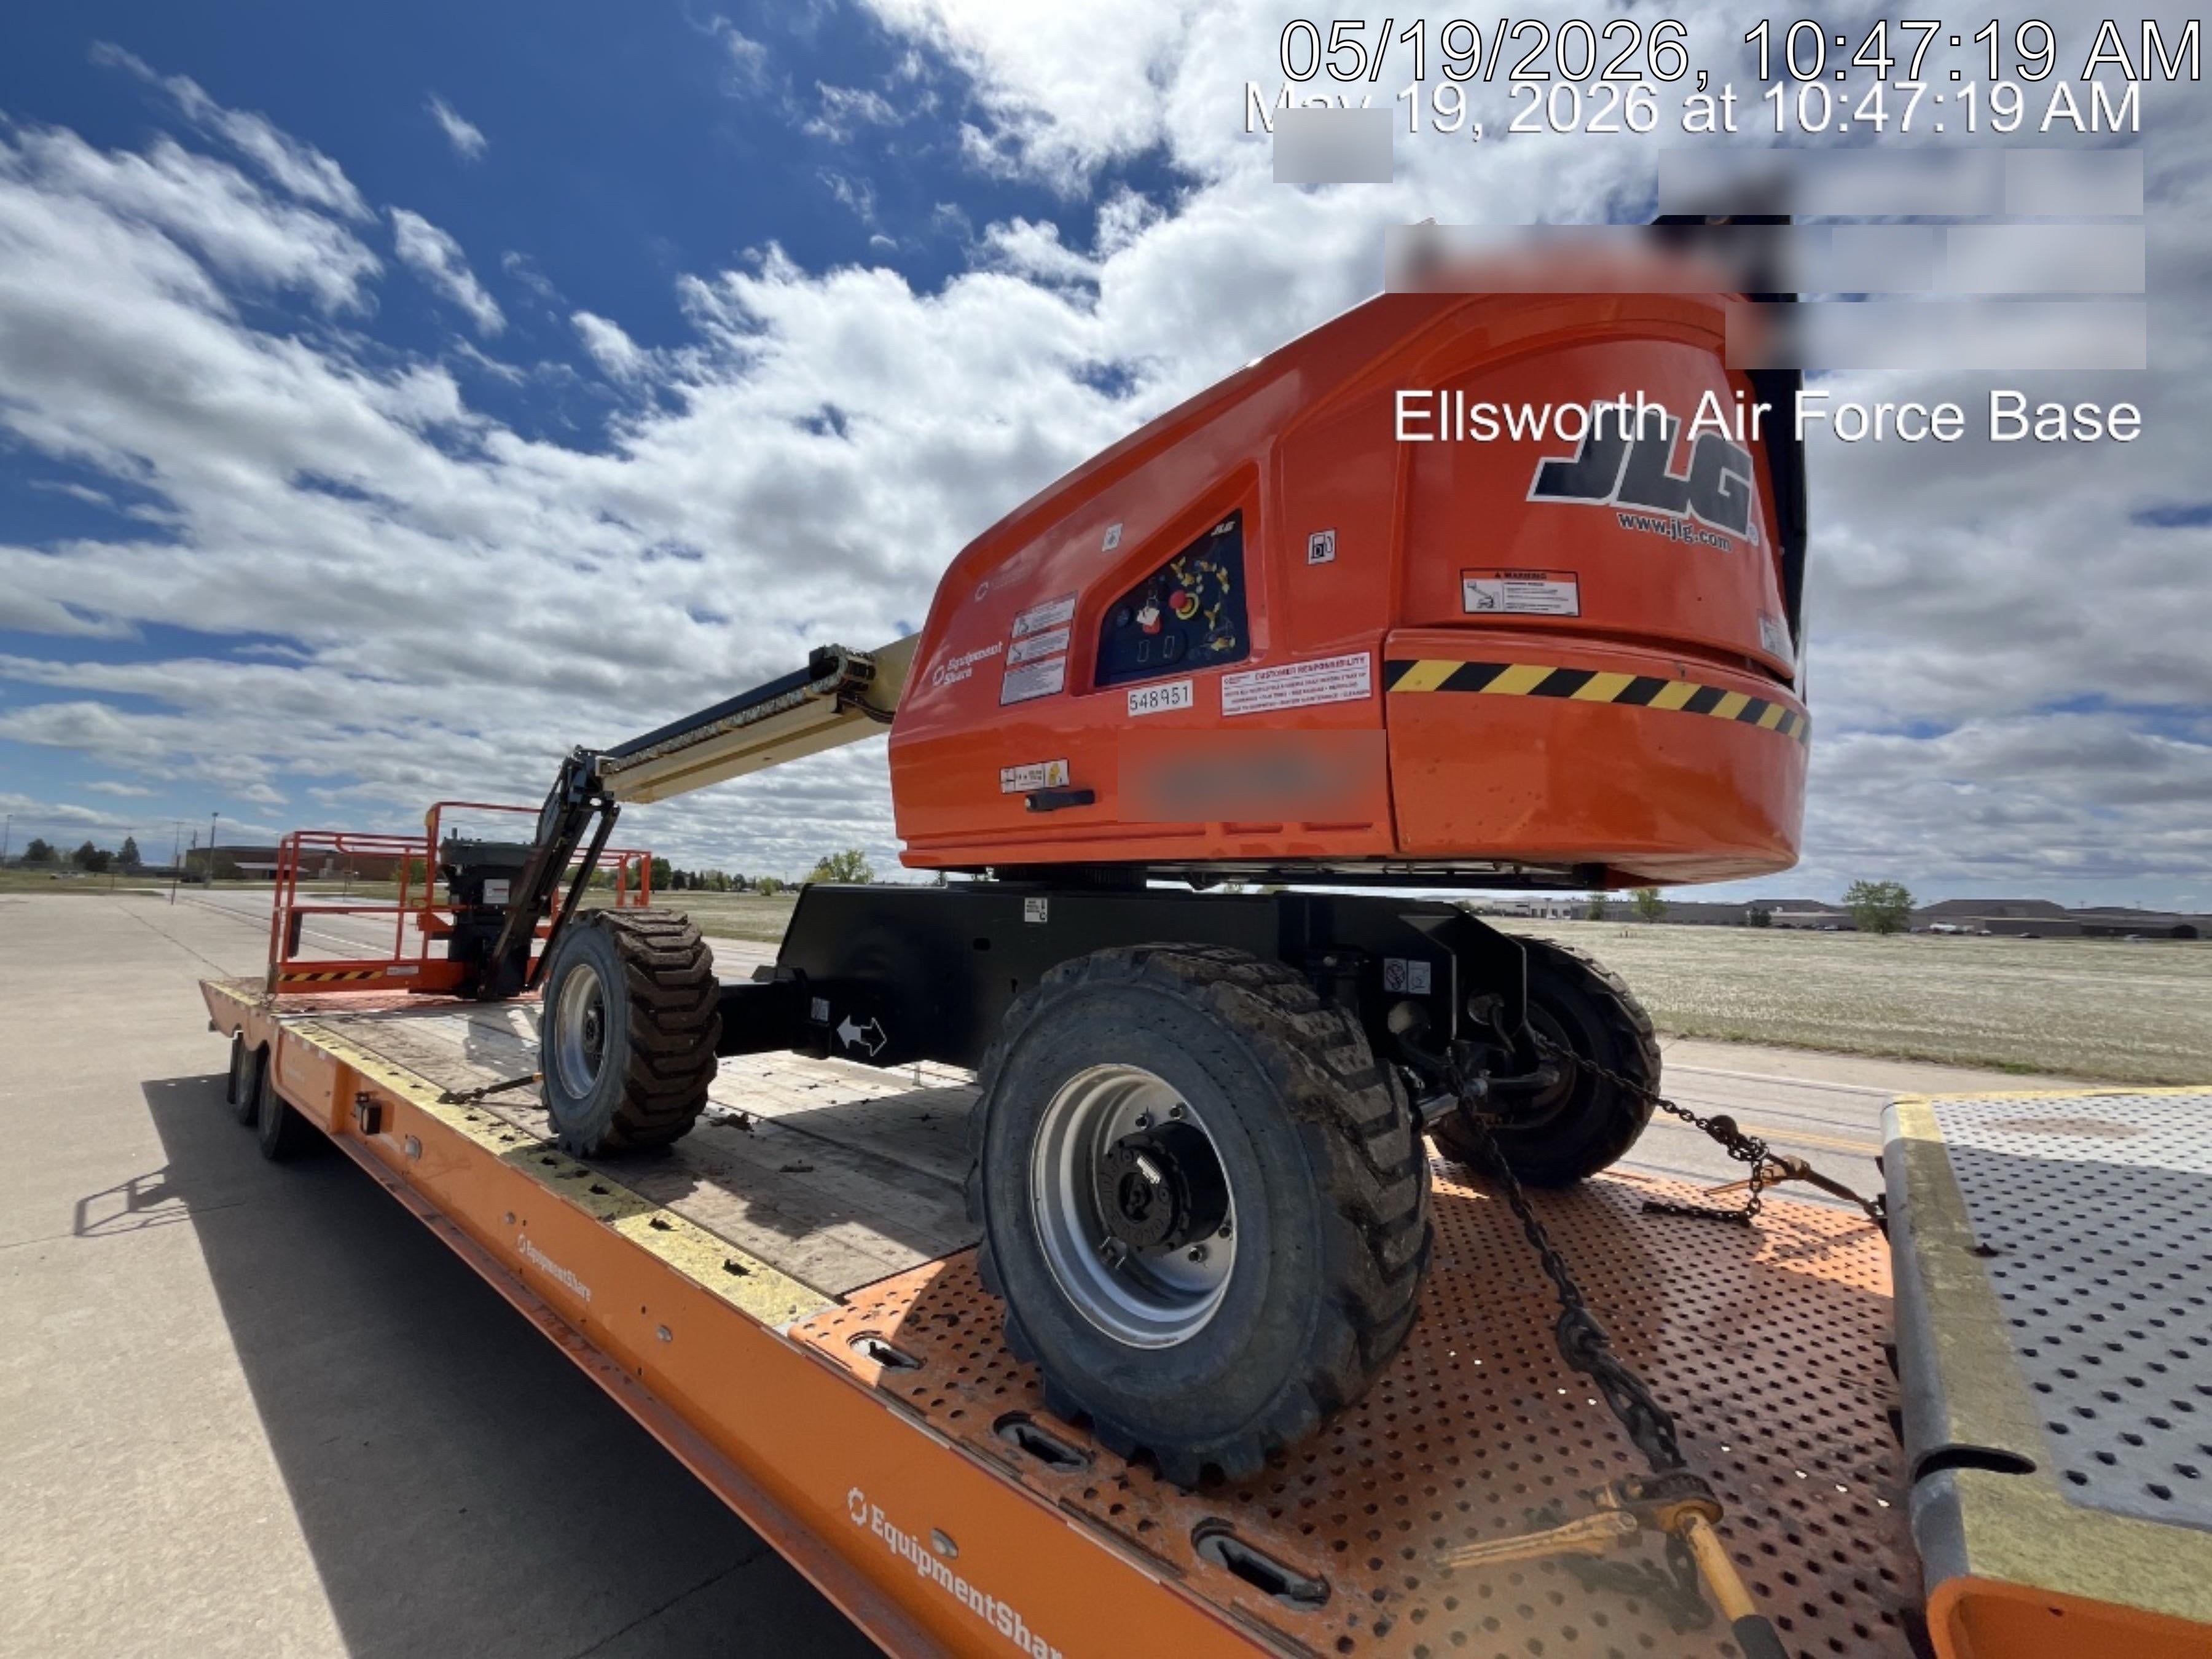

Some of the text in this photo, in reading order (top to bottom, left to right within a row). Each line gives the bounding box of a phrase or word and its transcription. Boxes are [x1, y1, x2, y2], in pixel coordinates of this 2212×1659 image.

[1526, 400, 1753, 541] JLG
[1617, 512, 1732, 552] www.jlg.com
[1129, 685, 1188, 711] 548951
